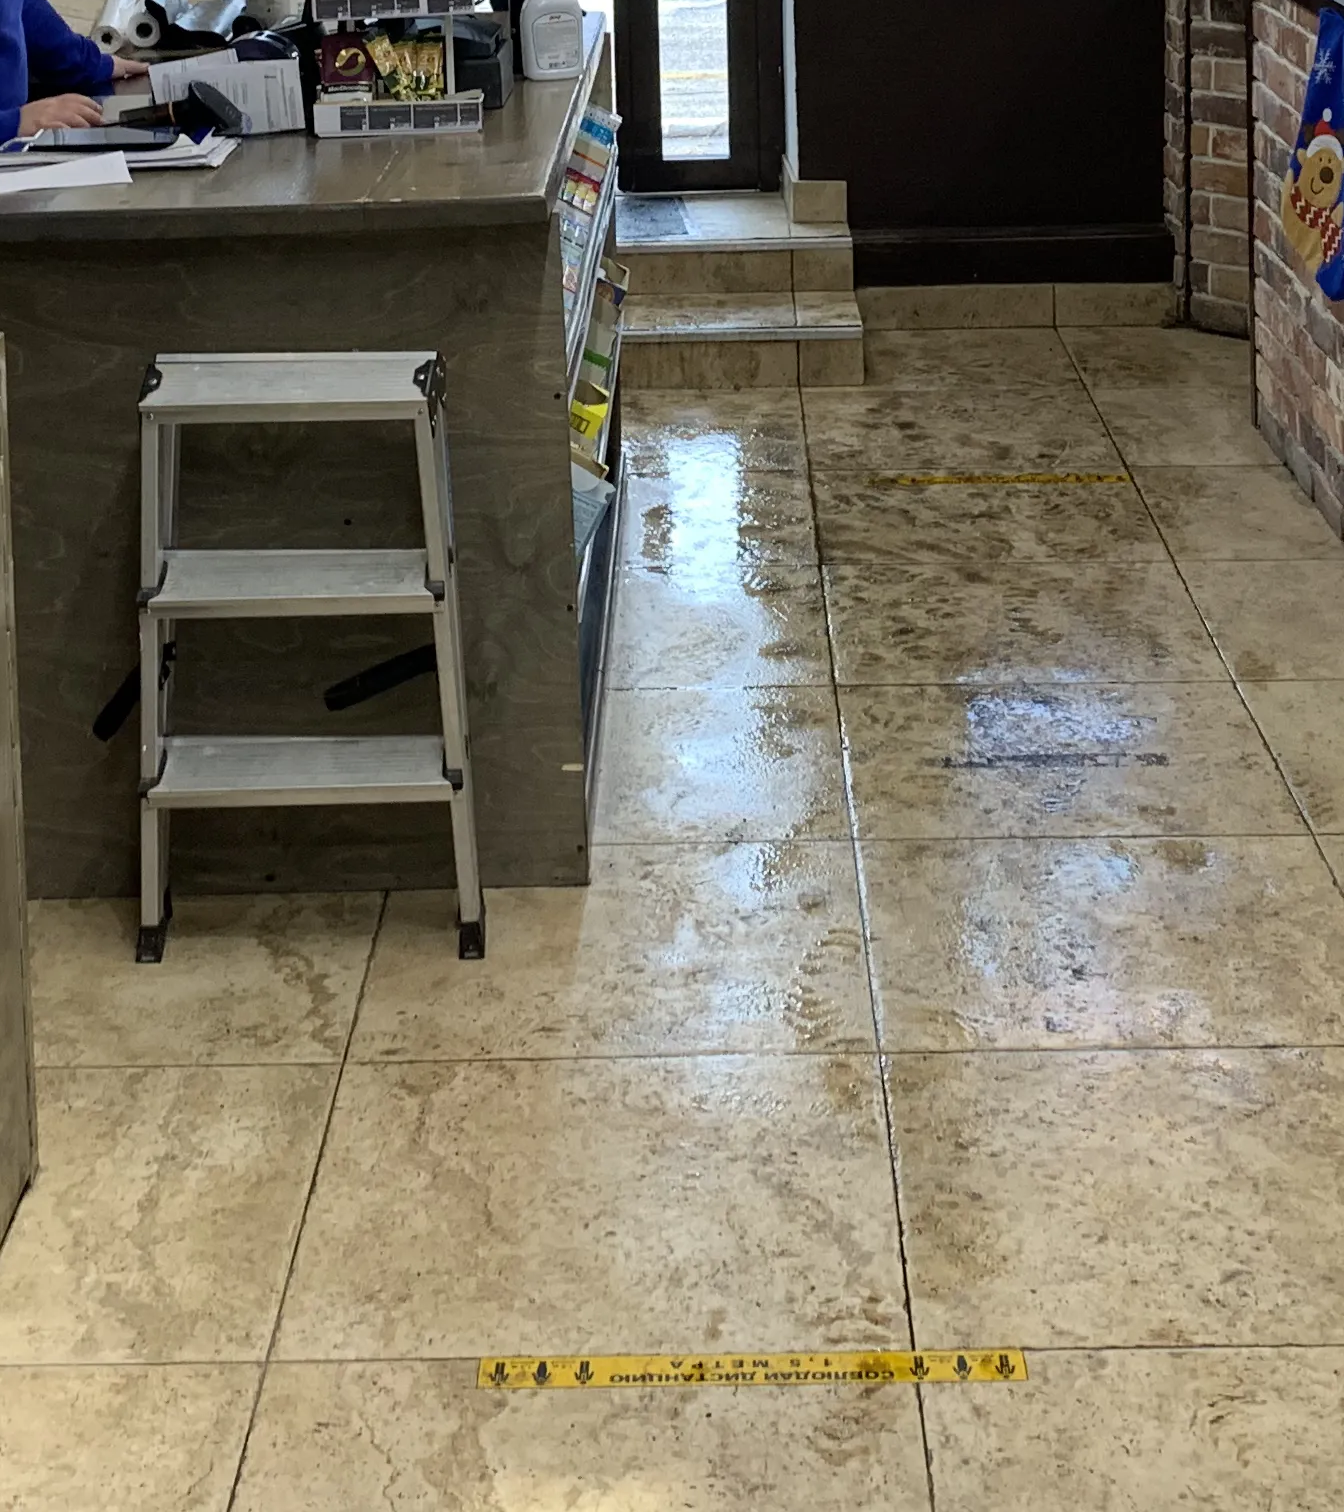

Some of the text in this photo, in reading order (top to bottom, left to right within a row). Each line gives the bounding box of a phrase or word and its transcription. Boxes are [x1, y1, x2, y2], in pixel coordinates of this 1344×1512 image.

[669, 1358, 769, 1370] МЕТРА
[608, 1368, 895, 1385] СОБЛЮДАЙ ДИСТАНЦИЮ
